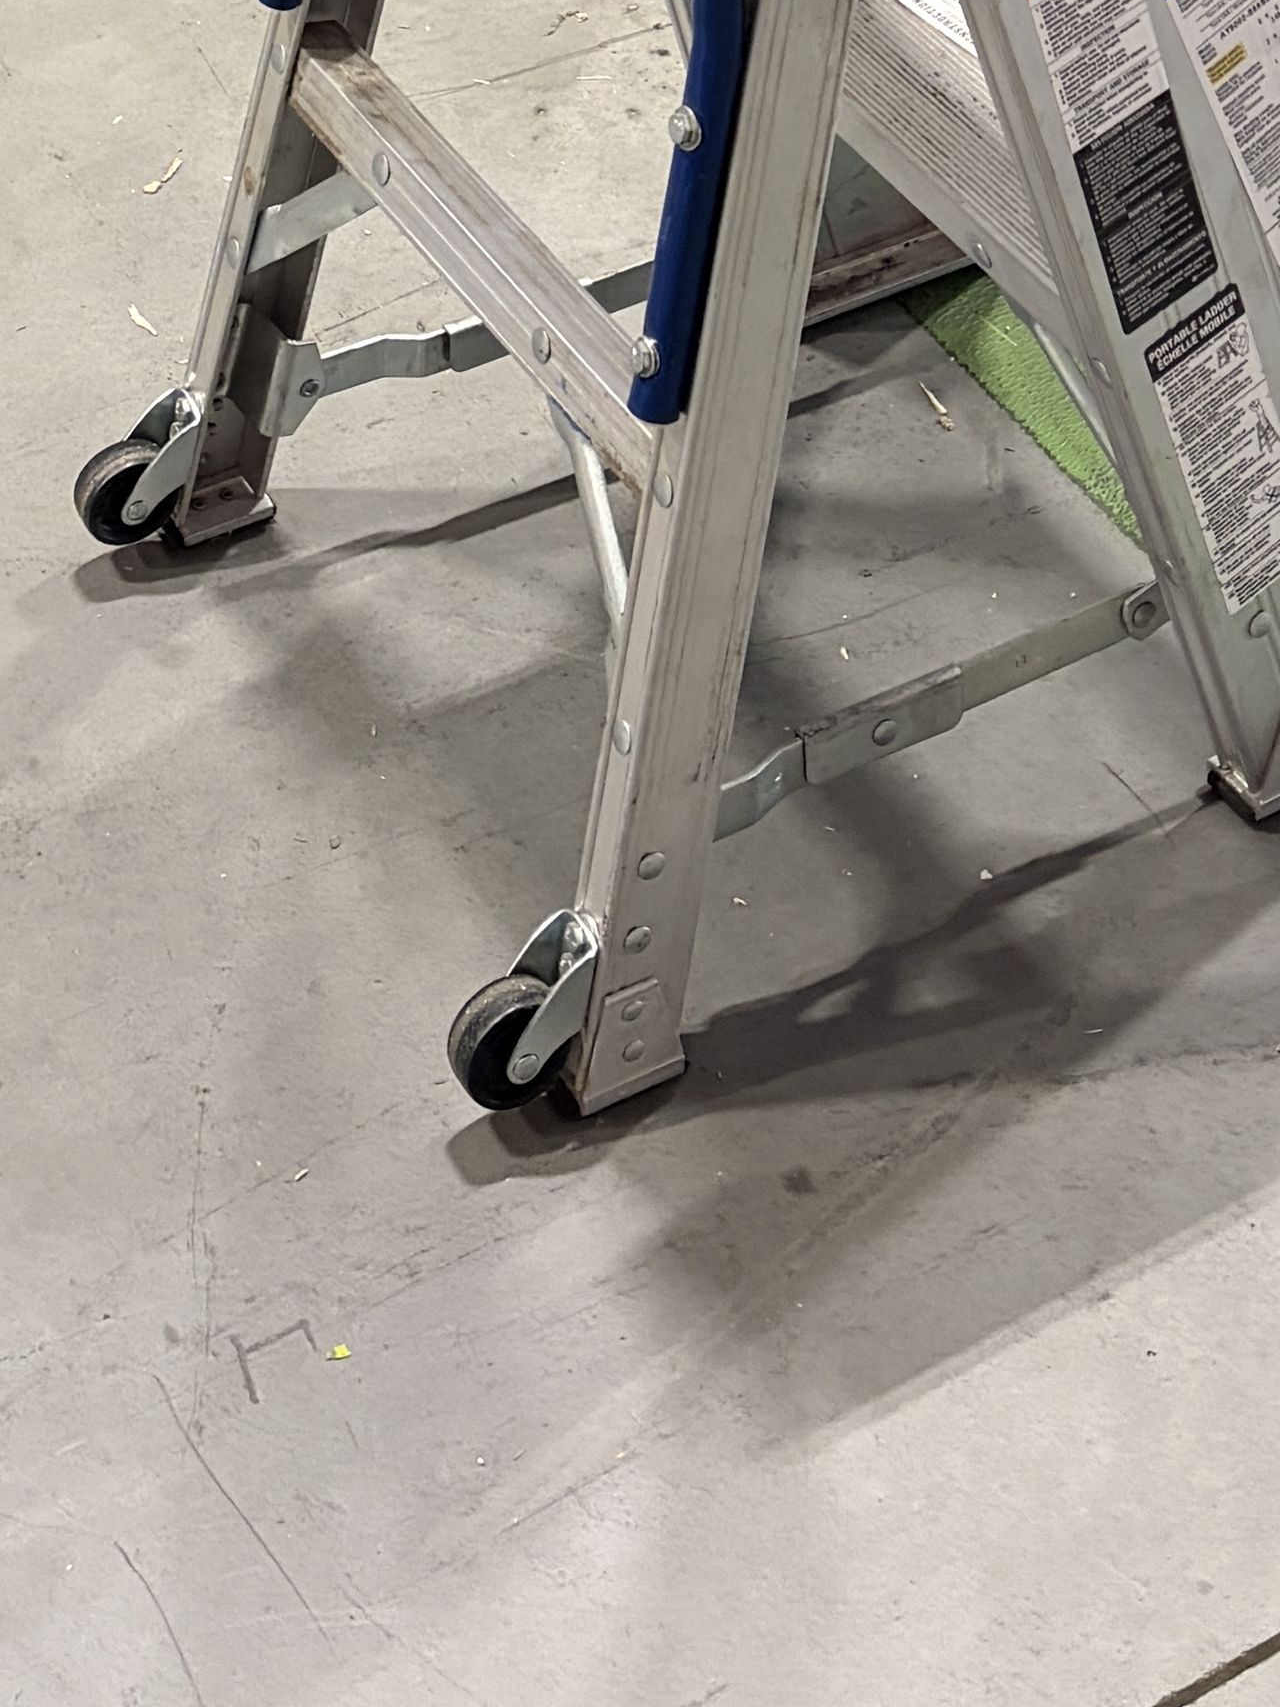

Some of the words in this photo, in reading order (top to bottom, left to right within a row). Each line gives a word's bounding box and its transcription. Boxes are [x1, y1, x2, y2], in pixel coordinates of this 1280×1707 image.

[1148, 319, 1199, 364] PORTABLE
[1198, 290, 1238, 324] LADDER
[1198, 304, 1236, 339] MOBILE
